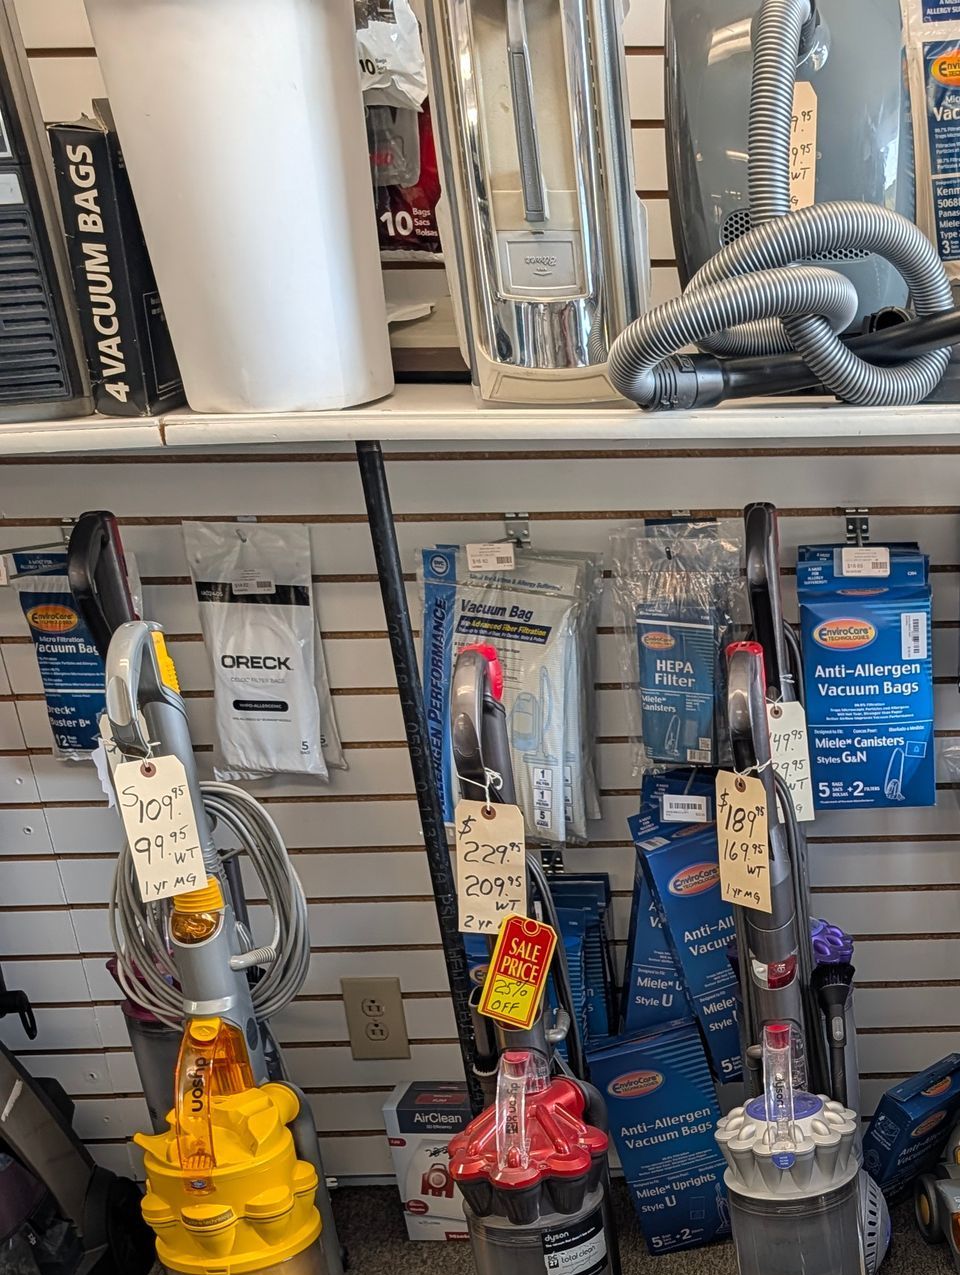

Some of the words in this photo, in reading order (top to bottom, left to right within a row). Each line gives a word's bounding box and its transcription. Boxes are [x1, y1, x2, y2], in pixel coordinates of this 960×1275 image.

[359, 59, 376, 75] 10
[66, 144, 105, 234] BAGS
[380, 211, 413, 237] 10
[413, 208, 431, 217] Bags
[414, 218, 430, 226] Sacs
[940, 231, 958, 239] Type
[942, 240, 950, 254] 3
[83, 243, 128, 377] VACUUM
[105, 383, 129, 402] 4
[32, 609, 73, 624] EnviroCare
[461, 600, 506, 616] Vacuum
[509, 605, 533, 621] Bag
[819, 627, 872, 641] EnviroCare
[221, 655, 291, 670] ORECK
[428, 598, 446, 722] PERFORMANCE
[656, 659, 693, 673] HEPA
[815, 663, 920, 678] Anti-Allergen
[655, 673, 696, 688] Filter
[818, 683, 879, 696] Vacuum
[883, 681, 919, 695] Bags
[301, 741, 309, 750] 5
[815, 738, 846, 748] Miele
[854, 737, 905, 748] Canisters
[817, 756, 841, 764] Styles
[842, 751, 867, 763] G&N
[818, 782, 830, 797] 5
[173, 845, 199, 865] WT
[673, 866, 719, 891] EnviroCare
[747, 864, 766, 878] WT
[153, 879, 169, 894] yr
[732, 886, 742, 898] yr
[496, 900, 521, 911] WT
[464, 916, 474, 928] 2
[683, 915, 735, 944] Anti-All
[509, 937, 542, 963] SALE
[500, 956, 539, 984] PRICE
[494, 979, 528, 998] 25%
[636, 977, 667, 989] Miele
[491, 1000, 520, 1013] OFF
[635, 995, 659, 1006] Style
[661, 993, 673, 1007] U
[703, 998, 732, 1016] Miele
[709, 1017, 732, 1032] Style
[721, 1059, 733, 1073] 5
[191, 1056, 209, 1111] dyson
[613, 1075, 659, 1093] EnviroCare
[414, 1112, 462, 1124] AirClean
[620, 1107, 711, 1137] Anti-Allergen
[625, 1128, 679, 1150] Vacuum
[682, 1120, 713, 1139] Bags
[636, 1185, 666, 1199] Miele
[673, 1172, 717, 1191] Uprights
[641, 1202, 665, 1213] Style
[665, 1195, 677, 1207] U
[544, 1231, 569, 1242] dyson
[651, 1236, 663, 1248] 5
[561, 1252, 578, 1263] total
[579, 1246, 596, 1257] clean
